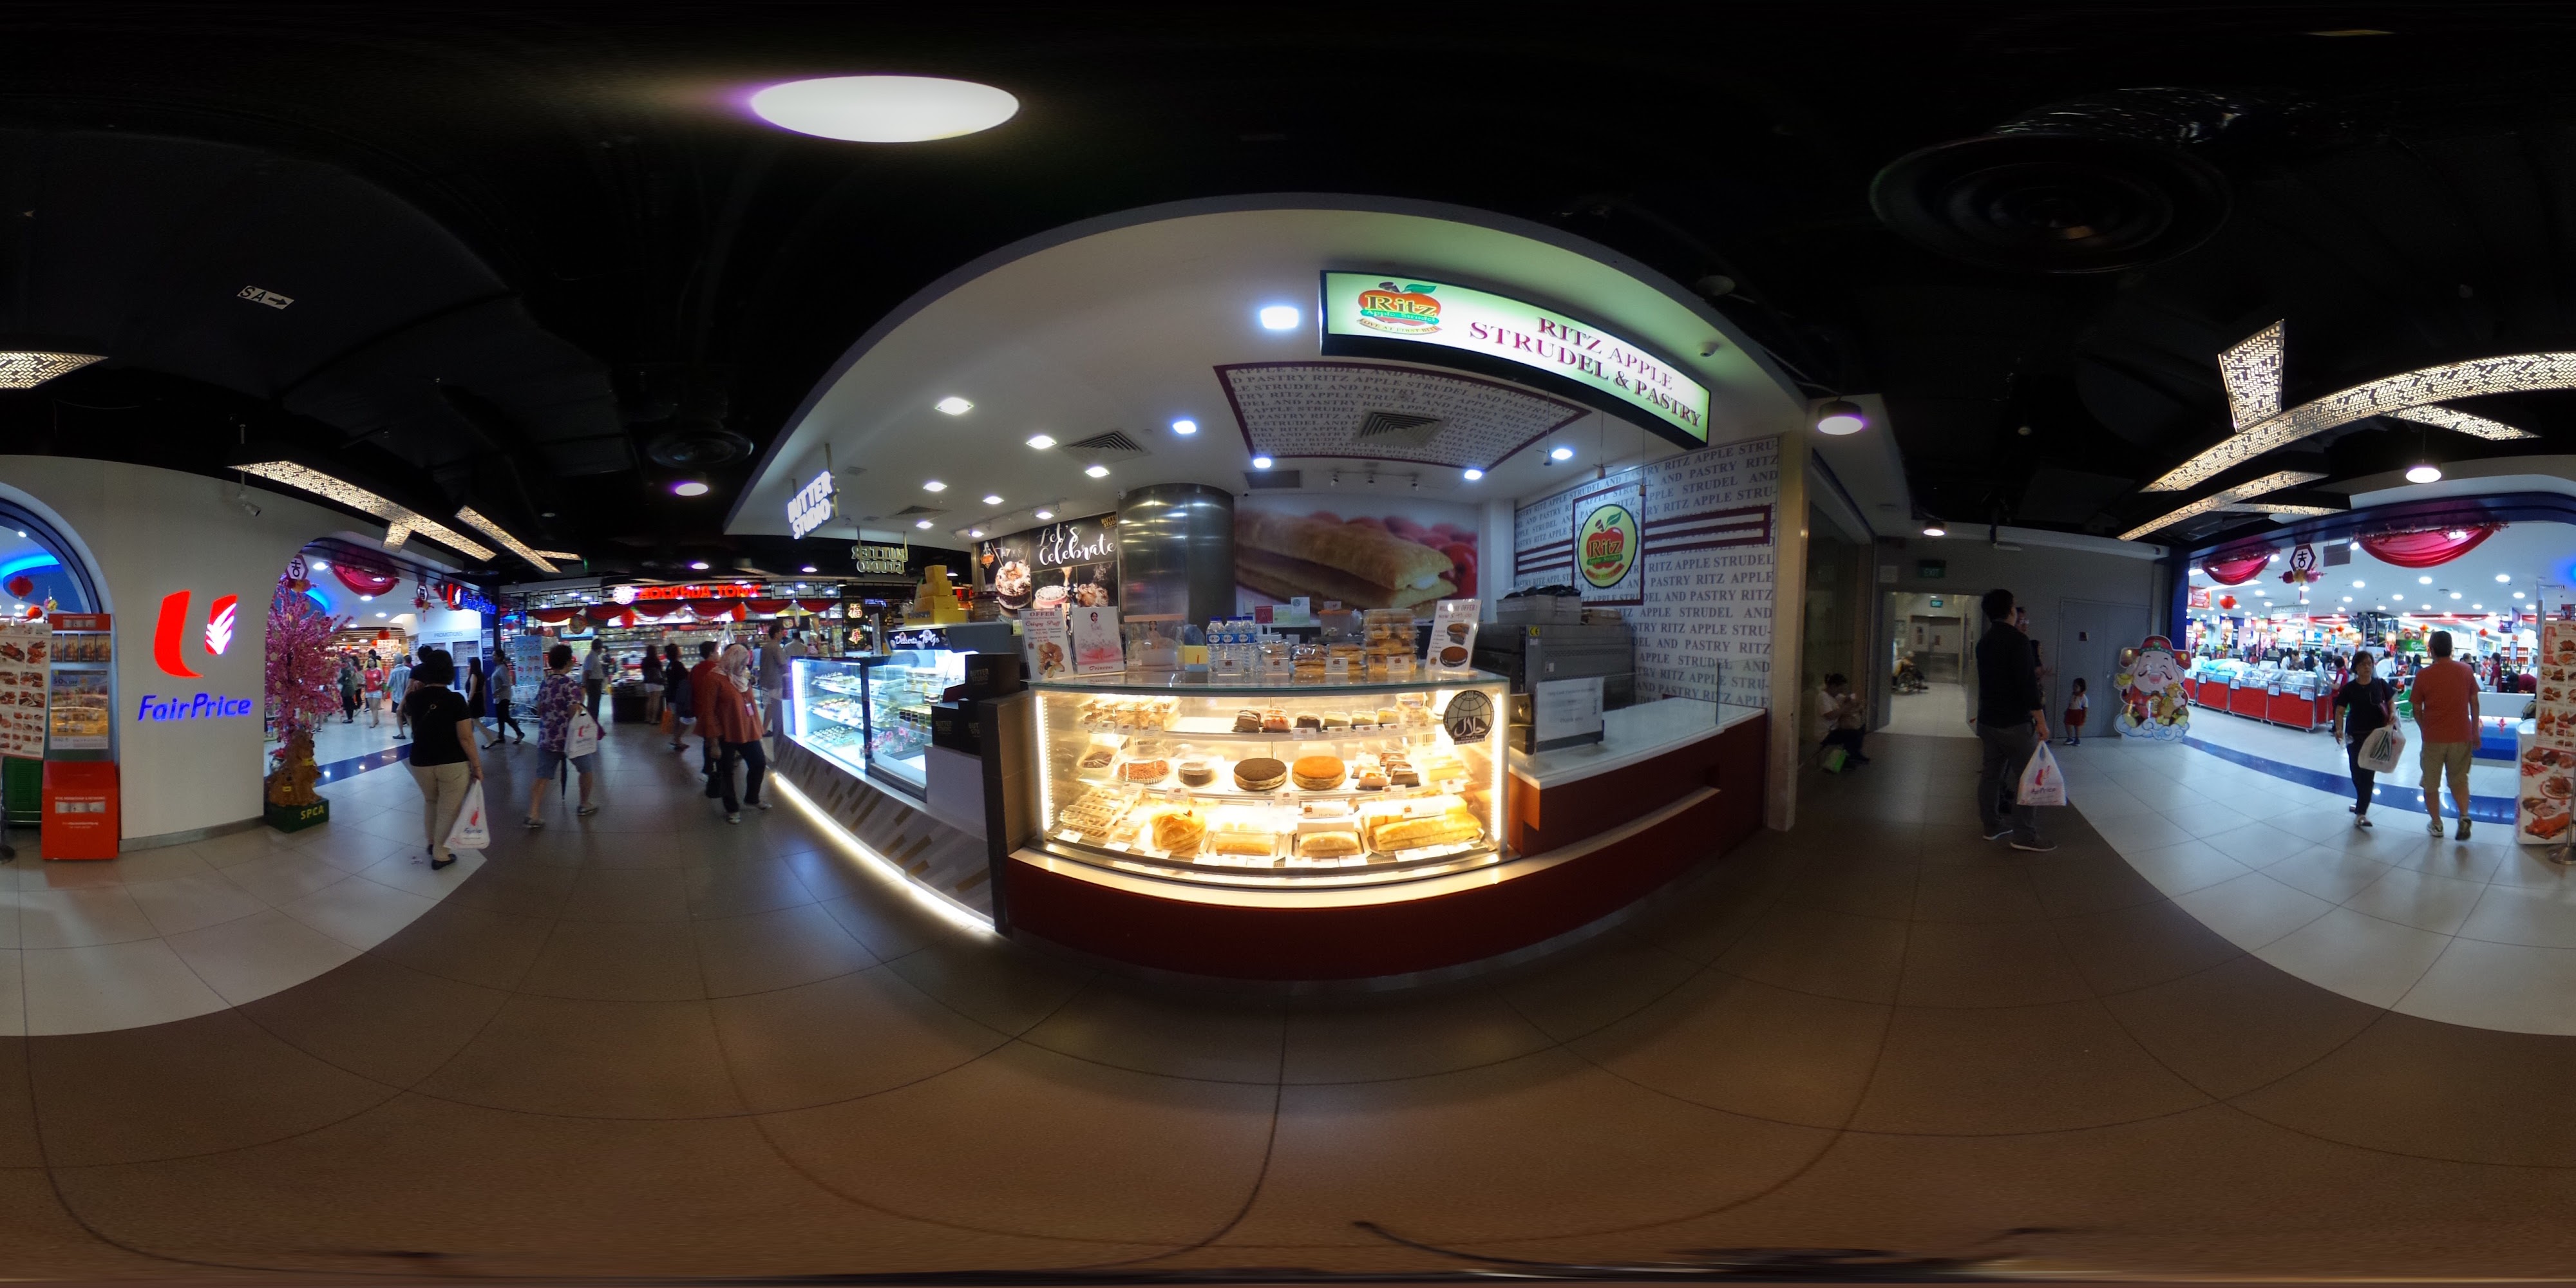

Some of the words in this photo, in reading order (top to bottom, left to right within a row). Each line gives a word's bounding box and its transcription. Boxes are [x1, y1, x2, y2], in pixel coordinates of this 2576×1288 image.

[1365, 294, 1437, 317] Ritz
[1367, 309, 1396, 317] Apple
[1401, 312, 1435, 322] Strudel
[1537, 317, 1602, 354] RITZ
[1608, 347, 1672, 390] APPLE
[1469, 321, 1609, 381] STRUDEL
[1613, 370, 1630, 390] &
[1634, 378, 1703, 428] PASTRY
[1569, 483, 1602, 500] STRUDEL
[1604, 476, 1622, 488] AND
[1665, 457, 1690, 471] RITZ
[1694, 446, 1734, 464] APPLE
[1739, 440, 1777, 456] STRU-
[1661, 473, 1683, 486] AND
[1690, 461, 1737, 479] PASTRY
[1746, 454, 1779, 469] RITZ
[1682, 477, 1738, 495] STRUDEL
[1748, 470, 1778, 484] AND
[788, 471, 833, 523] BUTTER
[1664, 499, 1689, 513] RITZ
[1693, 491, 1732, 507] APPLE
[1737, 488, 1777, 500] STRU-
[792, 498, 831, 540] STUDIO
[1036, 522, 1082, 548] Let's
[1039, 533, 1118, 566] Celebrate
[1589, 540, 1621, 558] Ritz
[1649, 562, 1672, 573] RITZ
[1675, 558, 1711, 571] APPLE
[1714, 554, 1774, 567] STRUDEL
[1651, 575, 1691, 587] PASTRY
[1696, 573, 1725, 585] RITZ
[1731, 571, 1774, 584] APPLE
[716, 585, 762, 598] TONIC
[1665, 592, 1687, 602] AND
[1690, 590, 1736, 601] PASTRY
[1741, 589, 1774, 601] RITZ
[1640, 607, 1671, 618] APPLE
[1680, 607, 1733, 618] STRUDEL
[1744, 607, 1772, 619] AND
[895, 635, 918, 645] Desserts
[919, 634, 929, 644] To
[930, 633, 940, 647] Go
[1661, 623, 1685, 634] RITZ
[1690, 624, 1727, 635] APPLE
[1732, 625, 1771, 636] STRU-
[1656, 638, 1678, 649] AND
[1685, 639, 1730, 652] PASTRY
[1739, 642, 1771, 655] RITZ
[1640, 652, 1670, 664] APPLE
[1678, 656, 1732, 670] STRUDEL
[1743, 660, 1770, 672] AND
[1660, 669, 1685, 681] RITZ
[1689, 673, 1727, 686] APPLE
[1732, 677, 1770, 690] STRU-
[137, 692, 252, 721] FairPrice
[1454, 716, 1486, 737] حلال
[300, 805, 325, 820] SPCA
